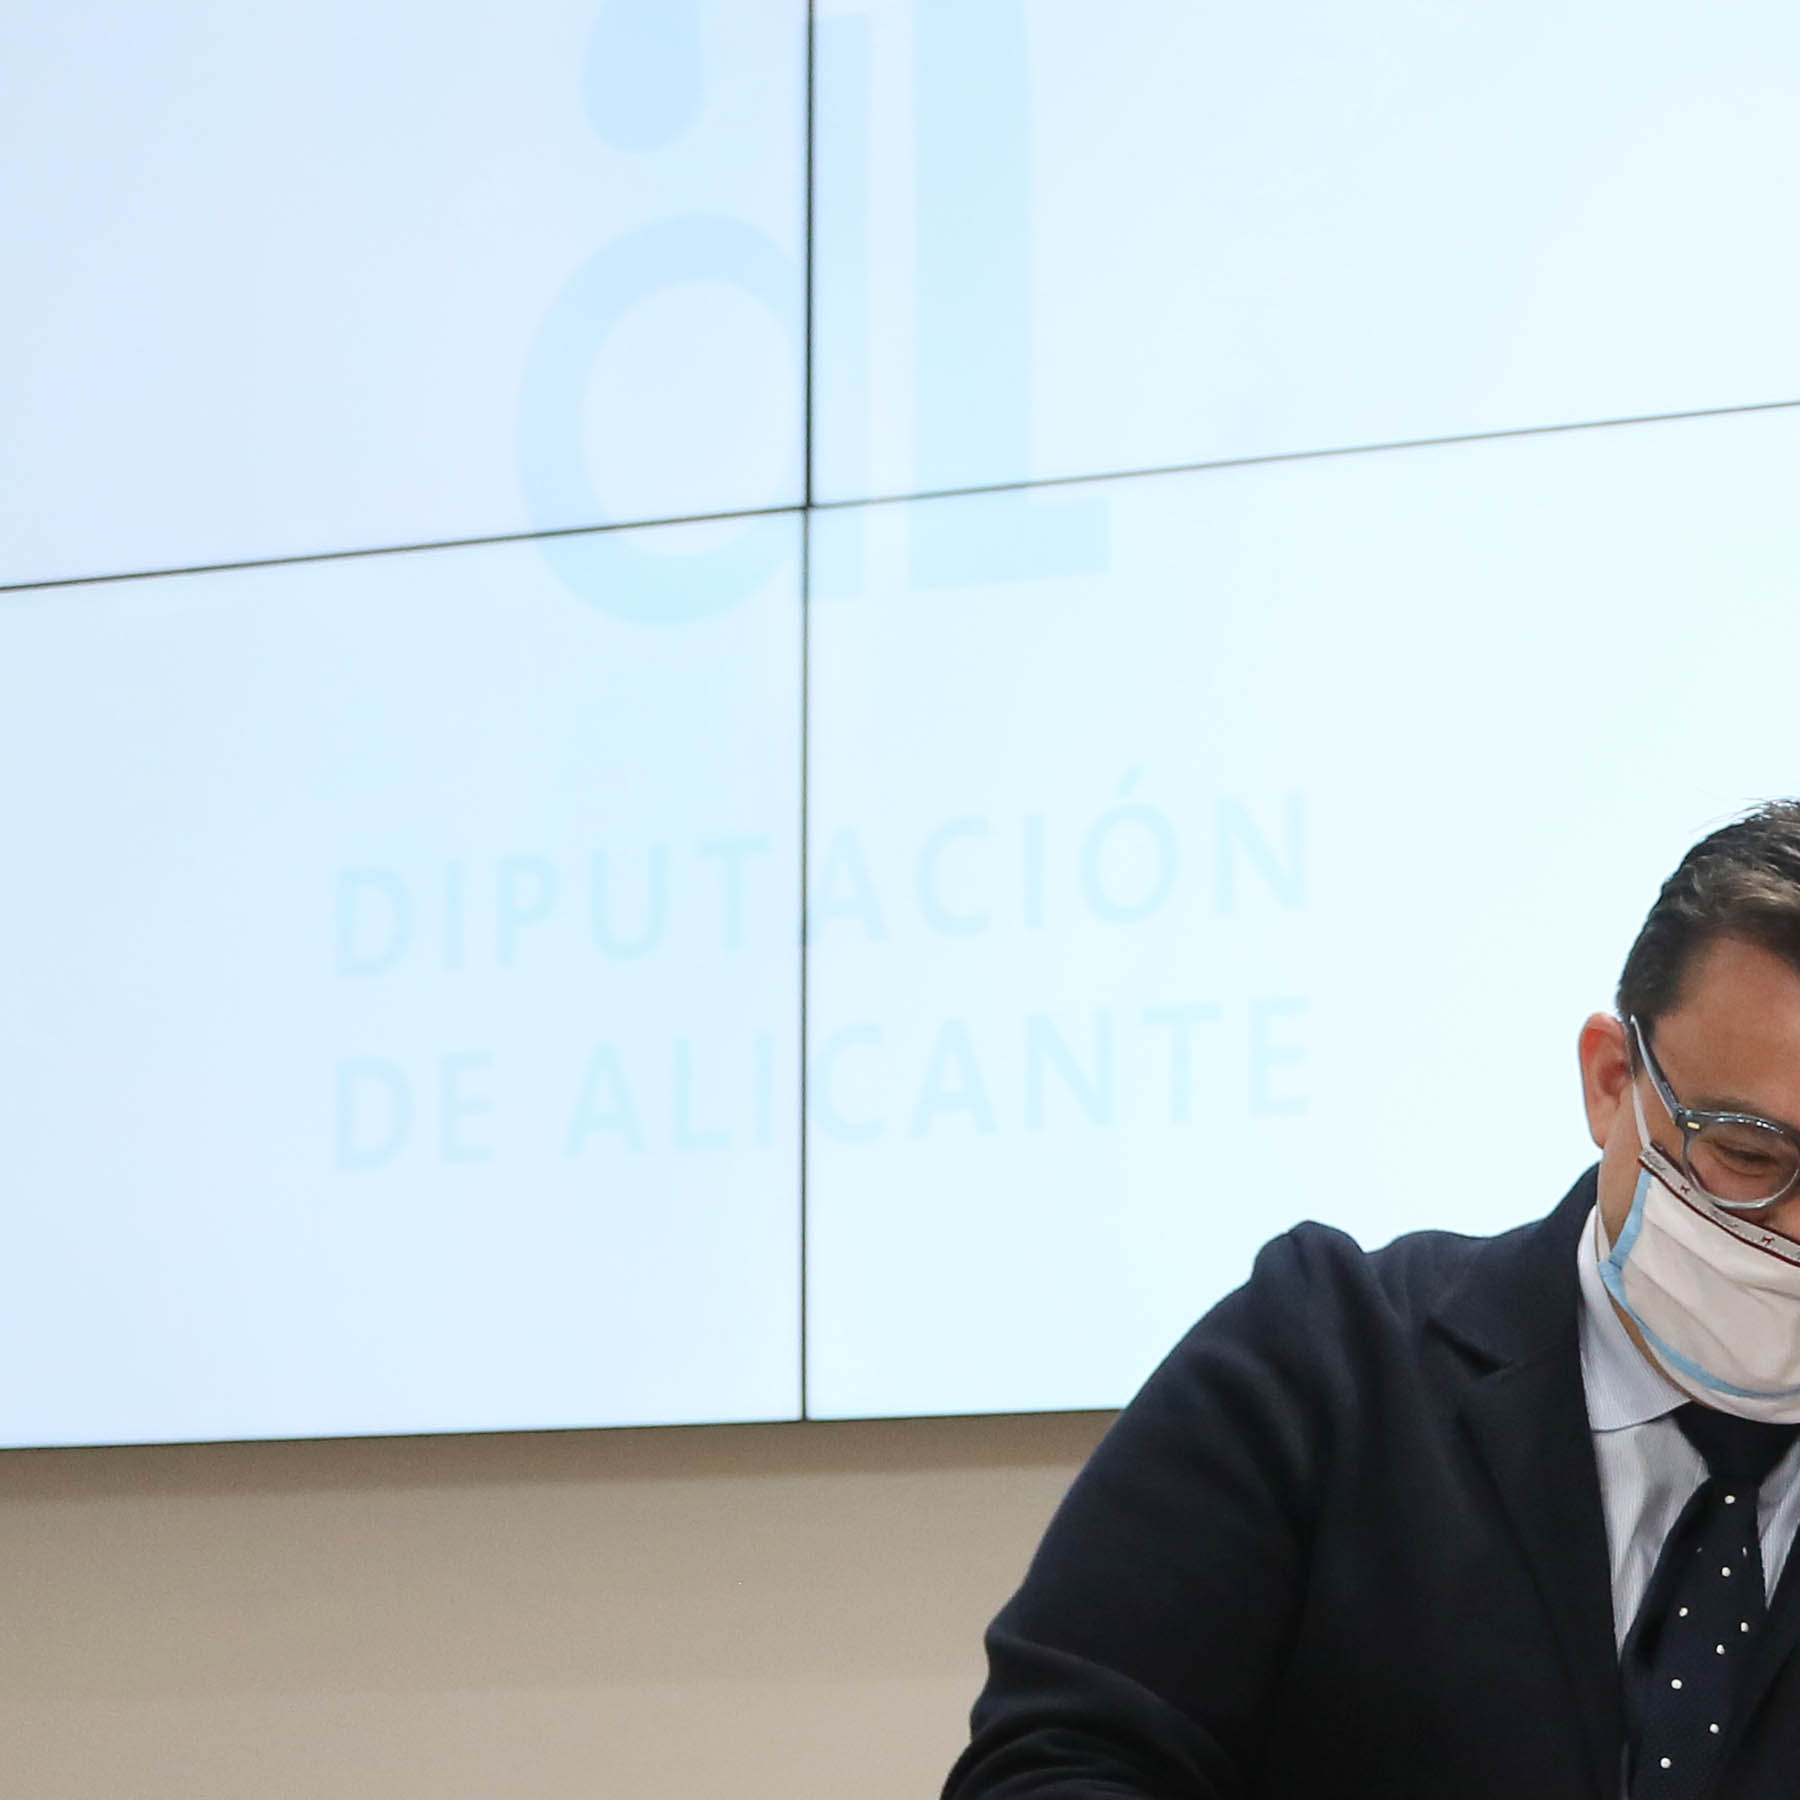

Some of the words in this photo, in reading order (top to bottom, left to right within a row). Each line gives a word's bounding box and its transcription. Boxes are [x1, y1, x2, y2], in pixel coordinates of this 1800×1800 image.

[329, 768, 1310, 982] DIPUTACIÓN
[329, 1050, 498, 1175] DE
[562, 997, 1310, 1164] ALICANTE
